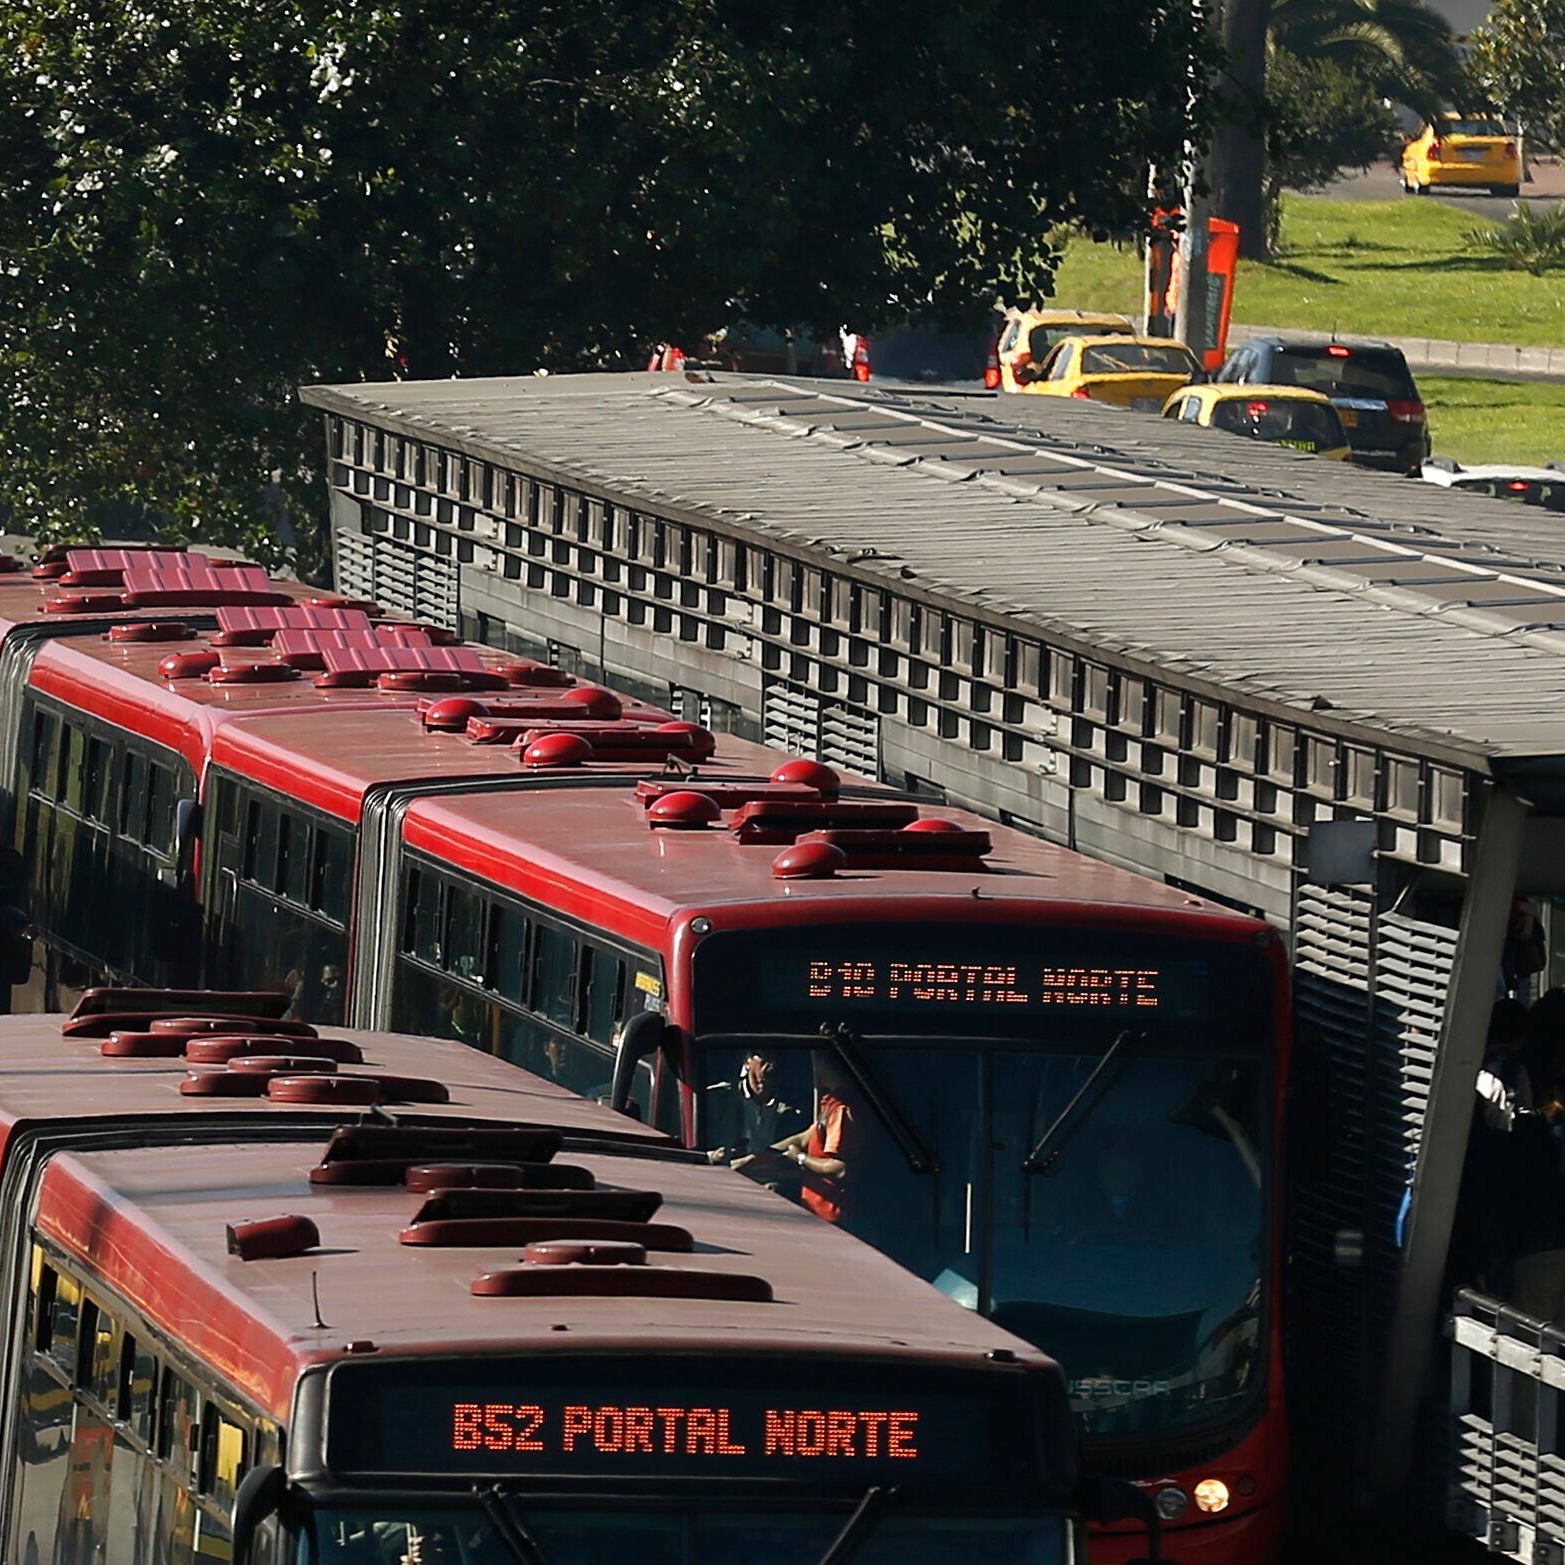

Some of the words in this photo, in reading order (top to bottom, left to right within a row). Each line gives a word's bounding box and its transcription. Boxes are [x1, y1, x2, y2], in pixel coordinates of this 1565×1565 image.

[889, 962, 1029, 1003] PORTAL
[1042, 967, 1159, 1006] NORTE
[453, 1403, 544, 1451] B52
[563, 1406, 746, 1455] PORTAL
[765, 1410, 919, 1458] NORTE
